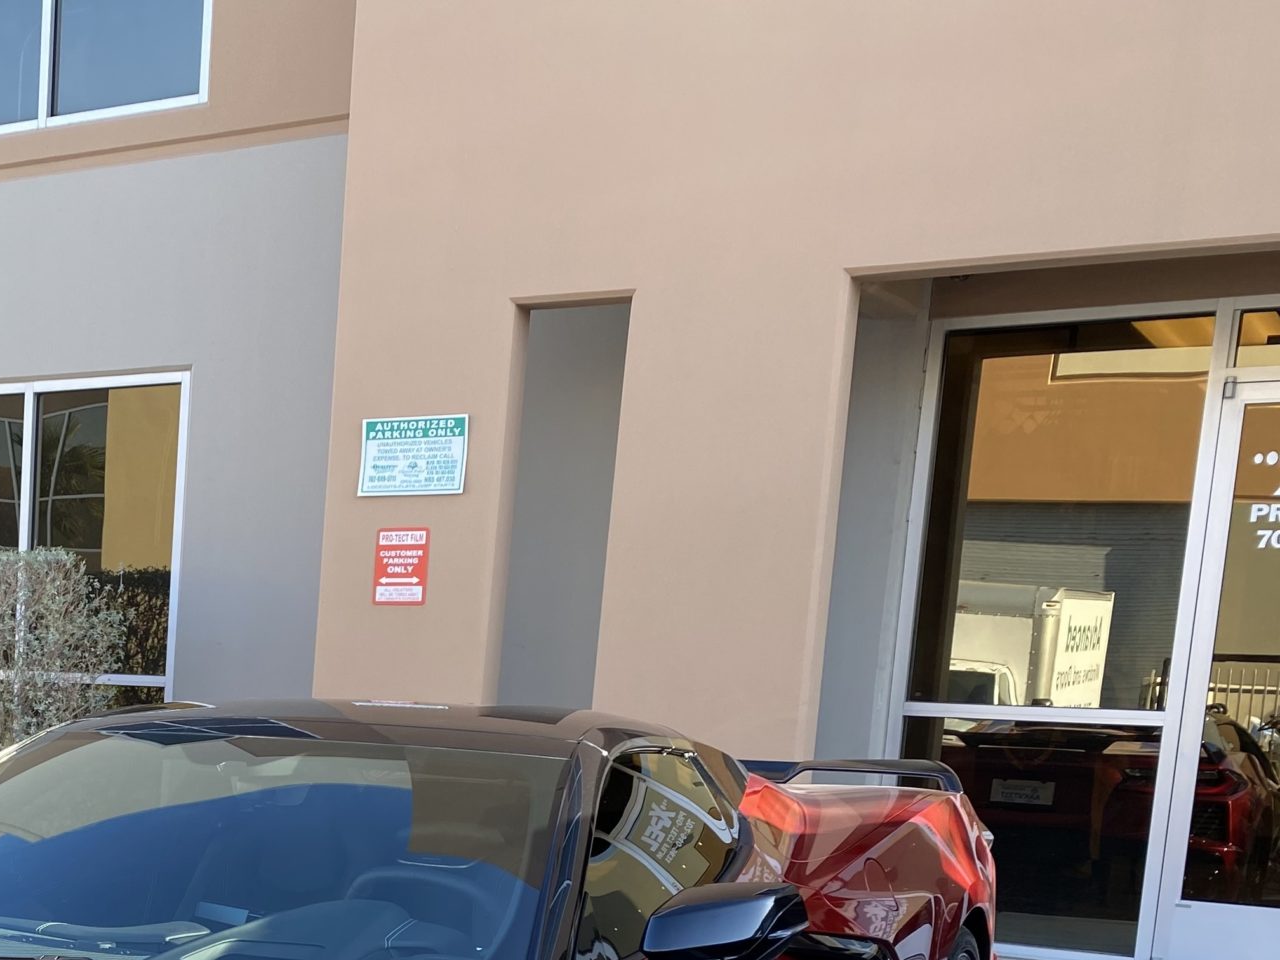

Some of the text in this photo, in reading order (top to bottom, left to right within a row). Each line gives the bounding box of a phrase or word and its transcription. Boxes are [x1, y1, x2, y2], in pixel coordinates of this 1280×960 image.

[375, 420, 455, 430] AUTHORIZED
[369, 427, 461, 439] PARKING ONLY
[381, 533, 424, 543] PRO-TECT FILM
[380, 549, 423, 557] CUSTOMER
[383, 557, 419, 565] PARKING
[386, 565, 414, 573] ONLY
